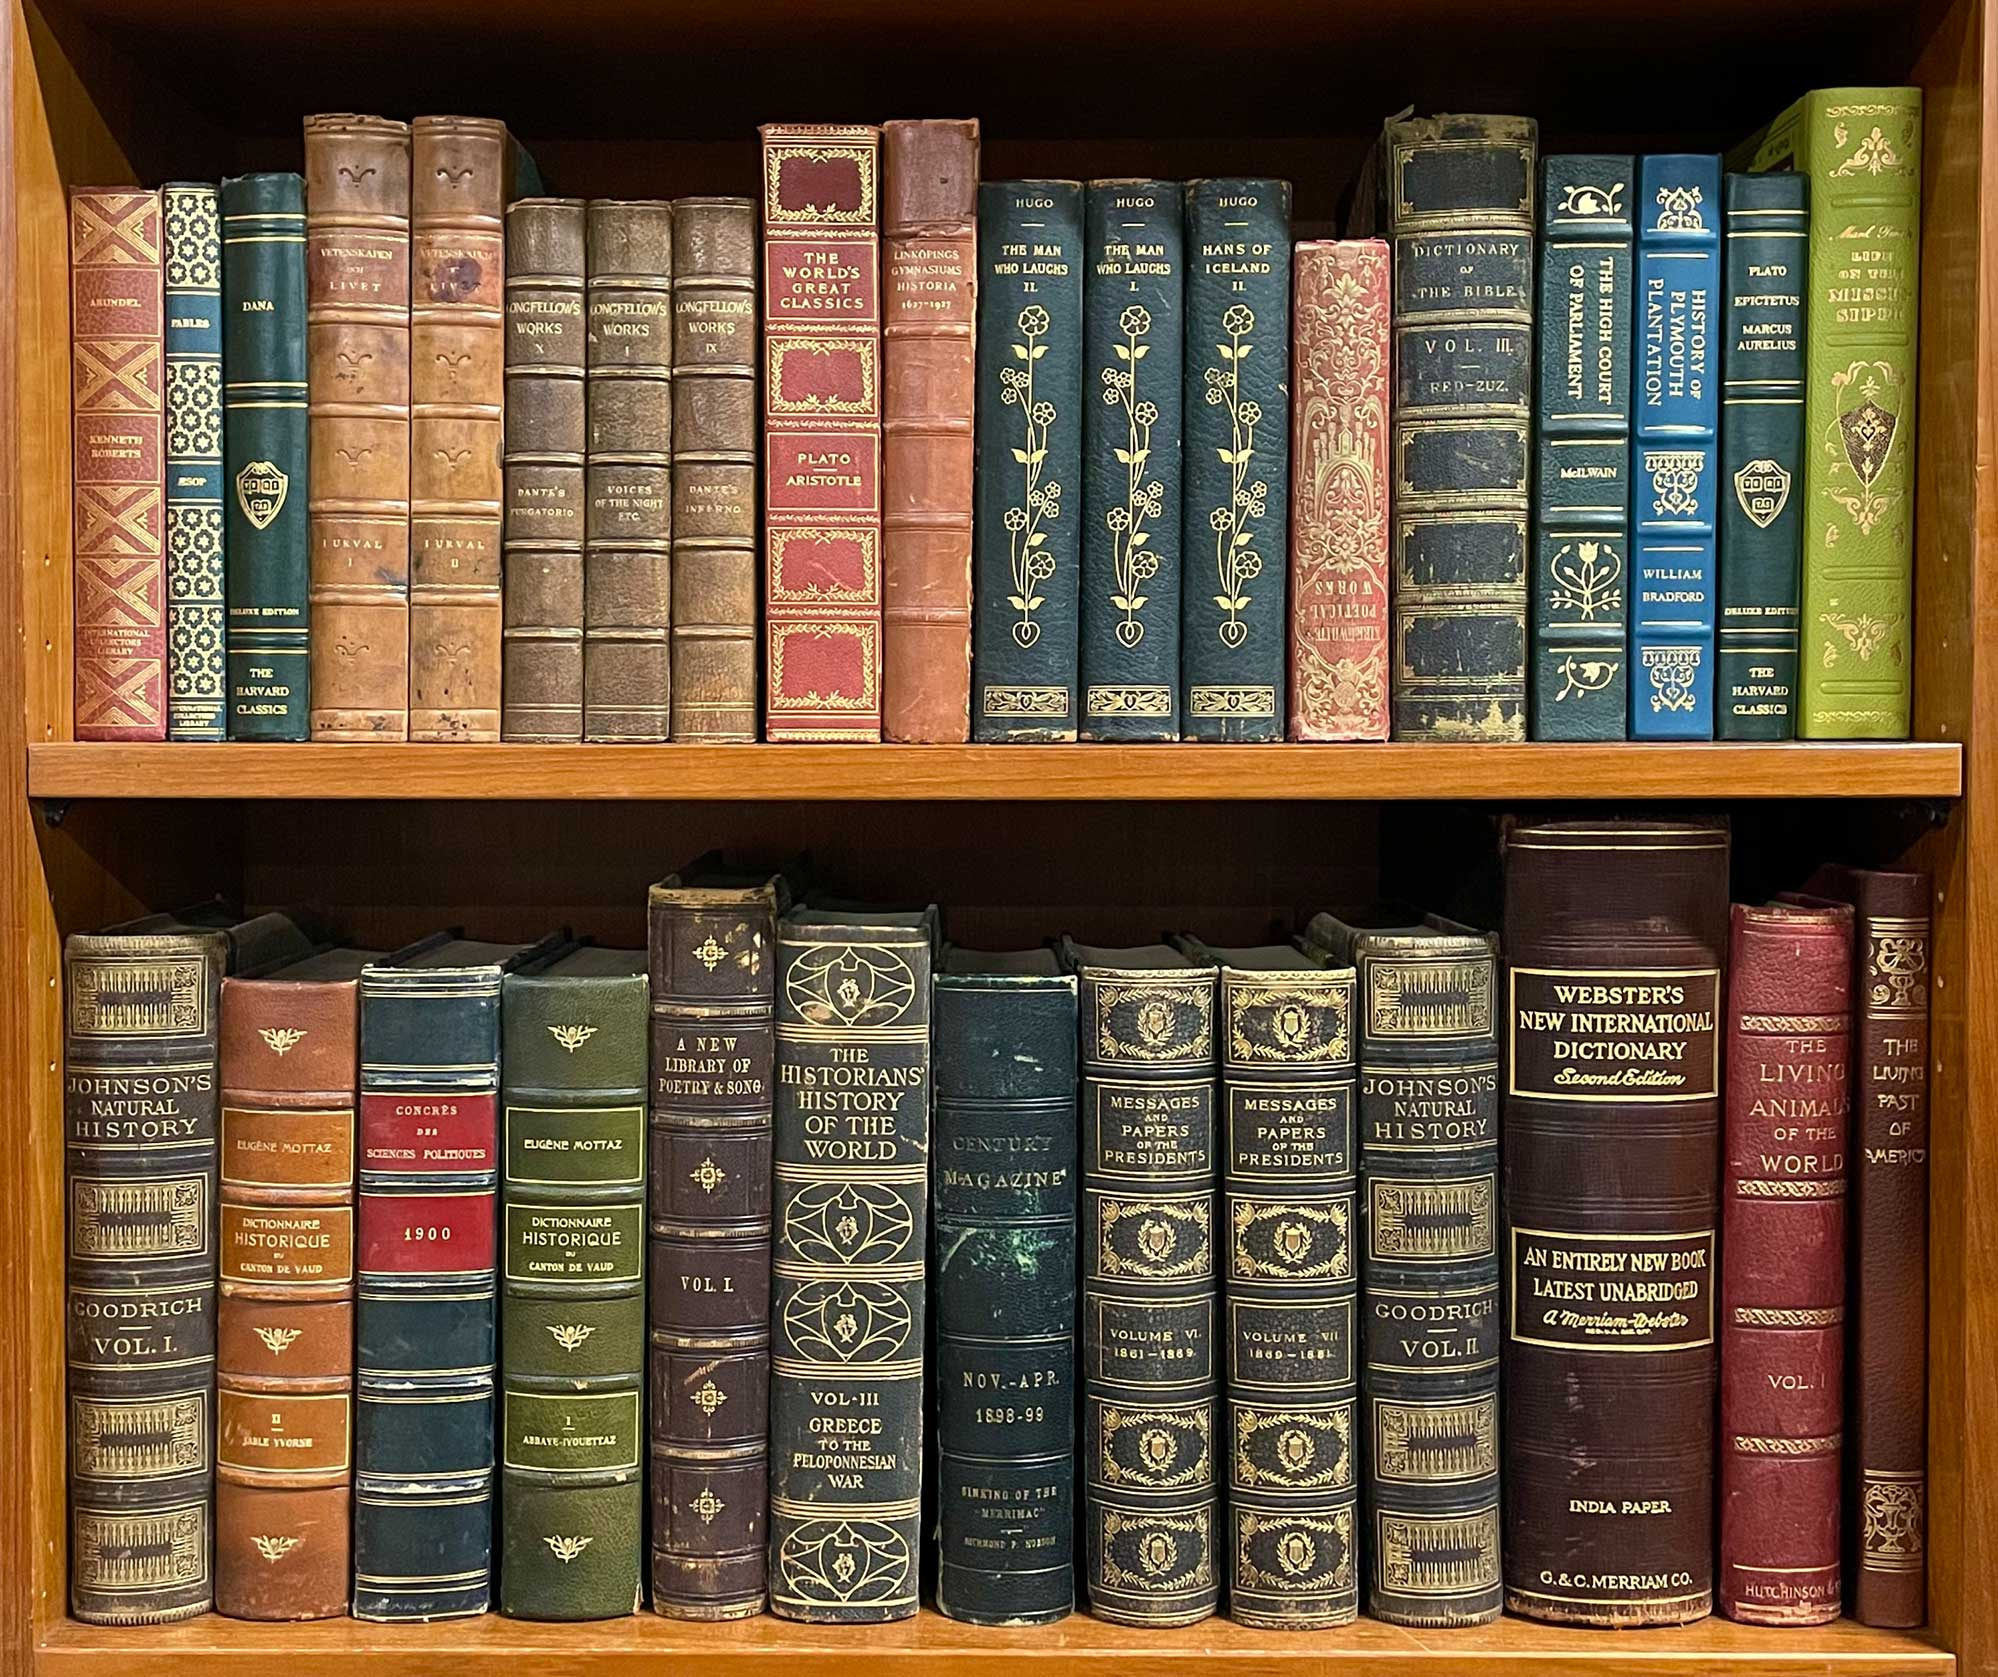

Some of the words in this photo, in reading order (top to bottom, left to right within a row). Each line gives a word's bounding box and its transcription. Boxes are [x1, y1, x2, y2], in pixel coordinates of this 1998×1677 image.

[1016, 198, 1054, 209] HUGO
[1116, 197, 1154, 208] HUGO
[1219, 196, 1258, 208] HUGO
[1002, 245, 1027, 256] THE
[1033, 245, 1061, 256] MAN
[1136, 245, 1164, 256] MAN
[1202, 244, 1246, 256] HANS
[1252, 244, 1273, 256] OF
[1414, 243, 1519, 257] DICTIONARY
[804, 252, 839, 265] THE
[782, 266, 860, 280] WORLD'S
[892, 265, 962, 276] GYMNASIUMS
[994, 263, 1019, 275] WHO
[1023, 263, 1068, 275] LAUGHS
[1125, 263, 1171, 275] LAUGHS
[1206, 263, 1271, 274] ICELAND
[1599, 256, 1613, 294] THE
[1749, 266, 1787, 277] PLATO
[1569, 265, 1584, 288] OF
[329, 281, 381, 292] LIVET
[792, 283, 851, 295] GREAT
[897, 281, 956, 292] HISTORIA
[1417, 286, 1451, 299] THE
[242, 301, 274, 312] DANA
[506, 300, 581, 315] LONGFELLOW'S
[590, 300, 667, 317] LONGFELLOW'S
[676, 299, 753, 315] LONGFELLOW'S
[780, 298, 864, 309] CLASSICS
[1734, 296, 1800, 307] EPICTETUS
[171, 319, 210, 328] FABLES
[1599, 298, 1613, 342] HIGH
[516, 322, 563, 335] WORKS
[603, 324, 650, 336] WORKS
[688, 321, 736, 334] WORKS
[1690, 289, 1706, 374] HISTORY
[1743, 324, 1792, 335] MARCUS
[1425, 338, 1482, 354] VOL.
[1568, 292, 1584, 400] PARLIAMENT
[1646, 278, 1664, 406] PLANTATION
[1669, 291, 1686, 397] PLYMOUTH
[1738, 340, 1796, 350] AURELIUS
[1598, 346, 1612, 405] COURT
[1430, 380, 1509, 394] RED-ZUZ.
[798, 454, 851, 465] PLATO
[1560, 467, 1617, 479] McILWAIN
[786, 475, 862, 487] ARISTOTLE
[518, 486, 566, 498] DANTE'S
[607, 485, 652, 495] VOICES
[689, 484, 738, 495] DANTE'S
[632, 498, 664, 510] NIGHT
[686, 504, 741, 514] INFERNO
[332, 539, 383, 550] URVAL
[435, 540, 485, 550] URVAL
[1643, 569, 1702, 580] WILLIAM
[1315, 580, 1373, 595] WORKS
[1643, 591, 1704, 602] BRADFORD
[262, 608, 299, 616] EDITION
[1310, 604, 1377, 618] POETICAL
[1724, 607, 1762, 616] DELUXE
[1749, 667, 1774, 678] THE
[236, 687, 289, 697] HARVARD
[1732, 686, 1789, 696] HARVARD
[237, 704, 287, 715] CLASSICS
[1733, 705, 1788, 715] CLASSICS
[1554, 985, 1684, 1005] WEBSTER'S
[1520, 1011, 1566, 1031] NEW
[1571, 1012, 1713, 1033] INTERNATIONAL
[697, 1037, 737, 1052] NEW
[1554, 1041, 1687, 1060] DICTIONARY
[1786, 1039, 1826, 1053] THE
[1883, 1039, 1918, 1055] THE
[829, 1048, 870, 1063] THE
[665, 1057, 726, 1073] LIBRARY
[733, 1058, 751, 1073] OF
[781, 1064, 925, 1087] HISTORIANS'
[1554, 1067, 1623, 1085] Second
[1622, 1068, 1686, 1086] Edition
[1760, 1063, 1845, 1083] LIVING
[1873, 1065, 1924, 1083] LIVING
[68, 1074, 211, 1095] JOHNSON'S
[659, 1078, 710, 1095] POETRY
[727, 1080, 761, 1095] SONG
[1363, 1075, 1496, 1096] JOHNSON'S
[92, 1099, 179, 1116] NATURAL
[799, 1091, 905, 1111] HISTORY
[1111, 1096, 1200, 1110] MESSAGES
[1245, 1098, 1337, 1111] MESSAGES
[1750, 1097, 1850, 1117] ANIMALS
[1876, 1094, 1919, 1110] PAST
[1394, 1100, 1476, 1117] NATURAL
[76, 1118, 198, 1137] HISTORY
[805, 1116, 838, 1135] OF
[845, 1116, 896, 1135] THE
[1121, 1125, 1189, 1137] PAPERS
[1374, 1119, 1487, 1139] HISTORY
[1257, 1127, 1326, 1140] PAPERS
[1774, 1128, 1799, 1140] OF
[1806, 1128, 1836, 1140] THE
[281, 1144, 332, 1153] MOTTAZ
[573, 1139, 623, 1150] MOTTAZ
[804, 1140, 897, 1159] WORLD
[953, 1136, 1053, 1152] CENTURY
[367, 1149, 416, 1159] SCIENCES
[424, 1149, 486, 1160] POLITIQUES
[1105, 1150, 1206, 1165] PRESIDENTS
[1239, 1152, 1343, 1166] PRESIDENTS
[1761, 1155, 1844, 1173] WORLD
[944, 1169, 1063, 1189] MAGAZINE
[243, 1218, 320, 1230] DICTIONNAIRE
[531, 1217, 612, 1228] DICTIONNAIRE
[235, 1232, 330, 1248] HISTORIQUE
[404, 1227, 451, 1241] 1900
[523, 1231, 622, 1247] HISTORIQUE
[1523, 1246, 1547, 1267] AN
[1552, 1250, 1627, 1272] ENTIRELY
[1631, 1253, 1668, 1272] NEW
[1671, 1249, 1706, 1271] BOOK
[240, 1263, 273, 1273] CANTON
[294, 1264, 323, 1273] VAUD
[529, 1262, 564, 1272] CANTON
[587, 1262, 614, 1272] VAUD
[681, 1276, 716, 1292] VOL.
[1533, 1278, 1595, 1300] LATEST
[1599, 1281, 1698, 1301] UNABRIDGED
[75, 1297, 202, 1318] GOODRICH
[1375, 1300, 1492, 1320] GOODRICH
[1559, 1309, 1688, 1329] Merriam-Webster
[1110, 1328, 1173, 1341] VOLUME
[1243, 1331, 1307, 1343] VOLUME
[95, 1338, 156, 1355] VOL.
[1401, 1341, 1462, 1358] VOL.
[1768, 1375, 1814, 1389] VOL.
[976, 1406, 1044, 1424] 1898-99
[809, 1417, 882, 1434] GREECE
[843, 1440, 871, 1451] THE
[793, 1453, 896, 1470] PELOPONNESIAN
[828, 1474, 864, 1489] WAR
[961, 1486, 1008, 1500] SINKING
[1569, 1499, 1616, 1513] INDIA
[1622, 1500, 1672, 1513] PAPER
[1592, 1574, 1668, 1590] MERRIAM
[1745, 1582, 1825, 1599] HUTCHINSON
